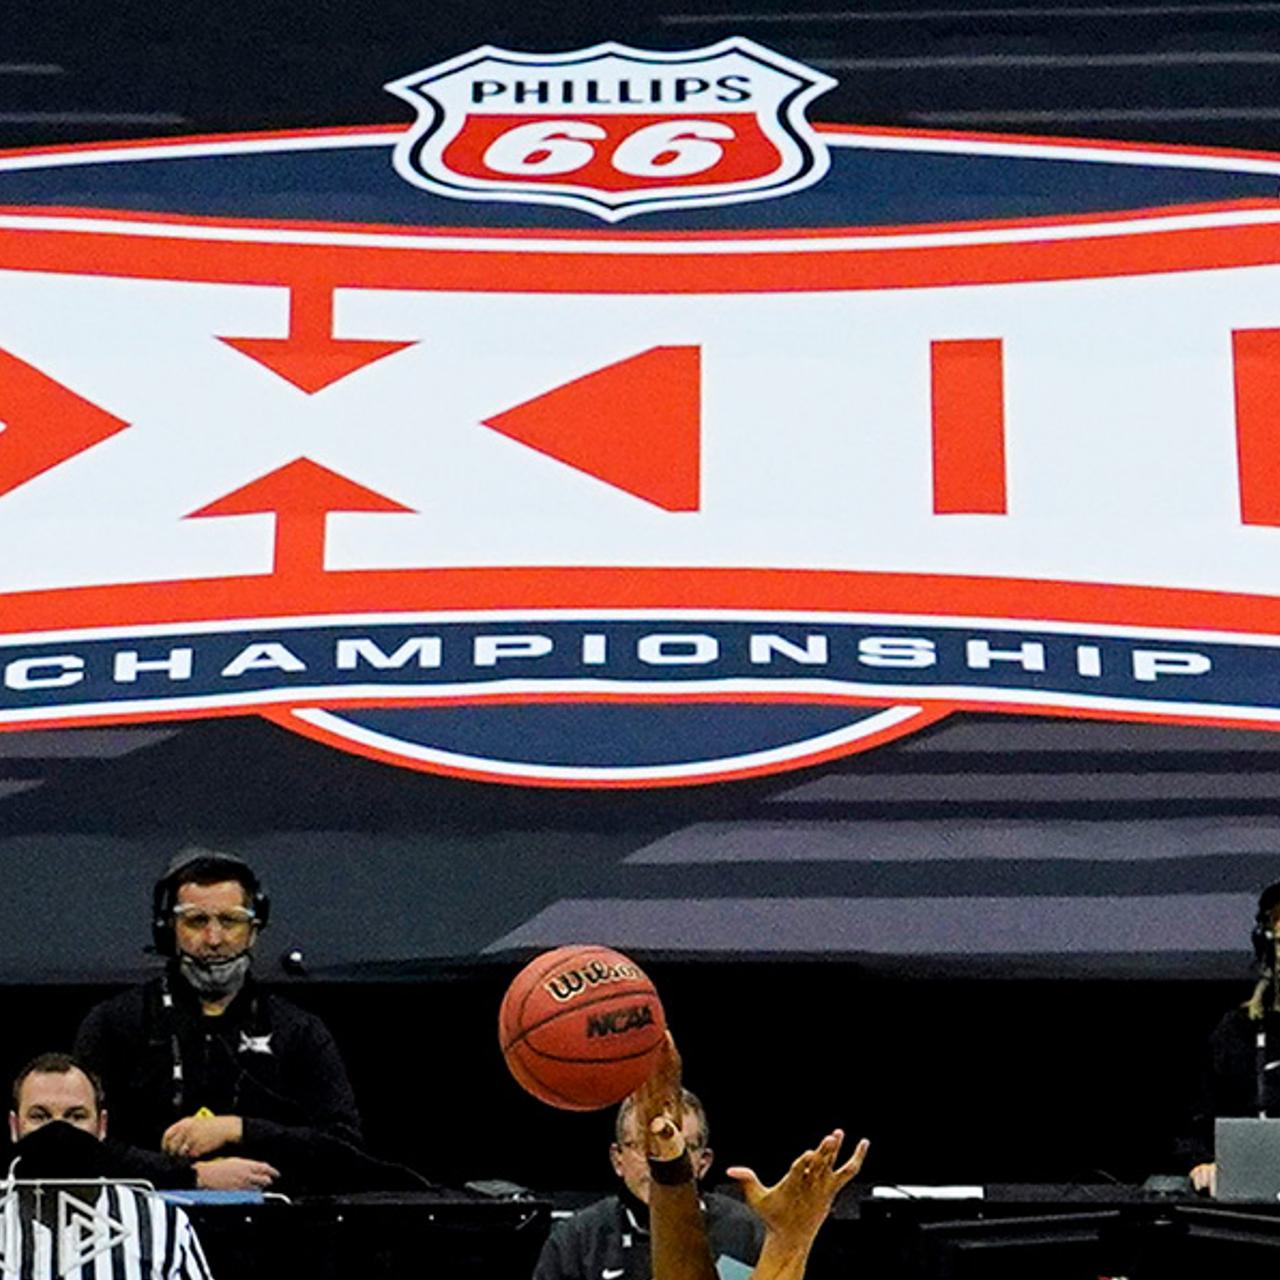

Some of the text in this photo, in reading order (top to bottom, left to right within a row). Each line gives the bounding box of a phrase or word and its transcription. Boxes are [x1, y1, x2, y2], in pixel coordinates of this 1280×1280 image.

[472, 75, 752, 104] PHILLIPS
[483, 120, 736, 178] 66
[5, 634, 1212, 690] CHAMPIONSHIP
[544, 960, 641, 1002] Wilson
[586, 1004, 657, 1038] NCAA
